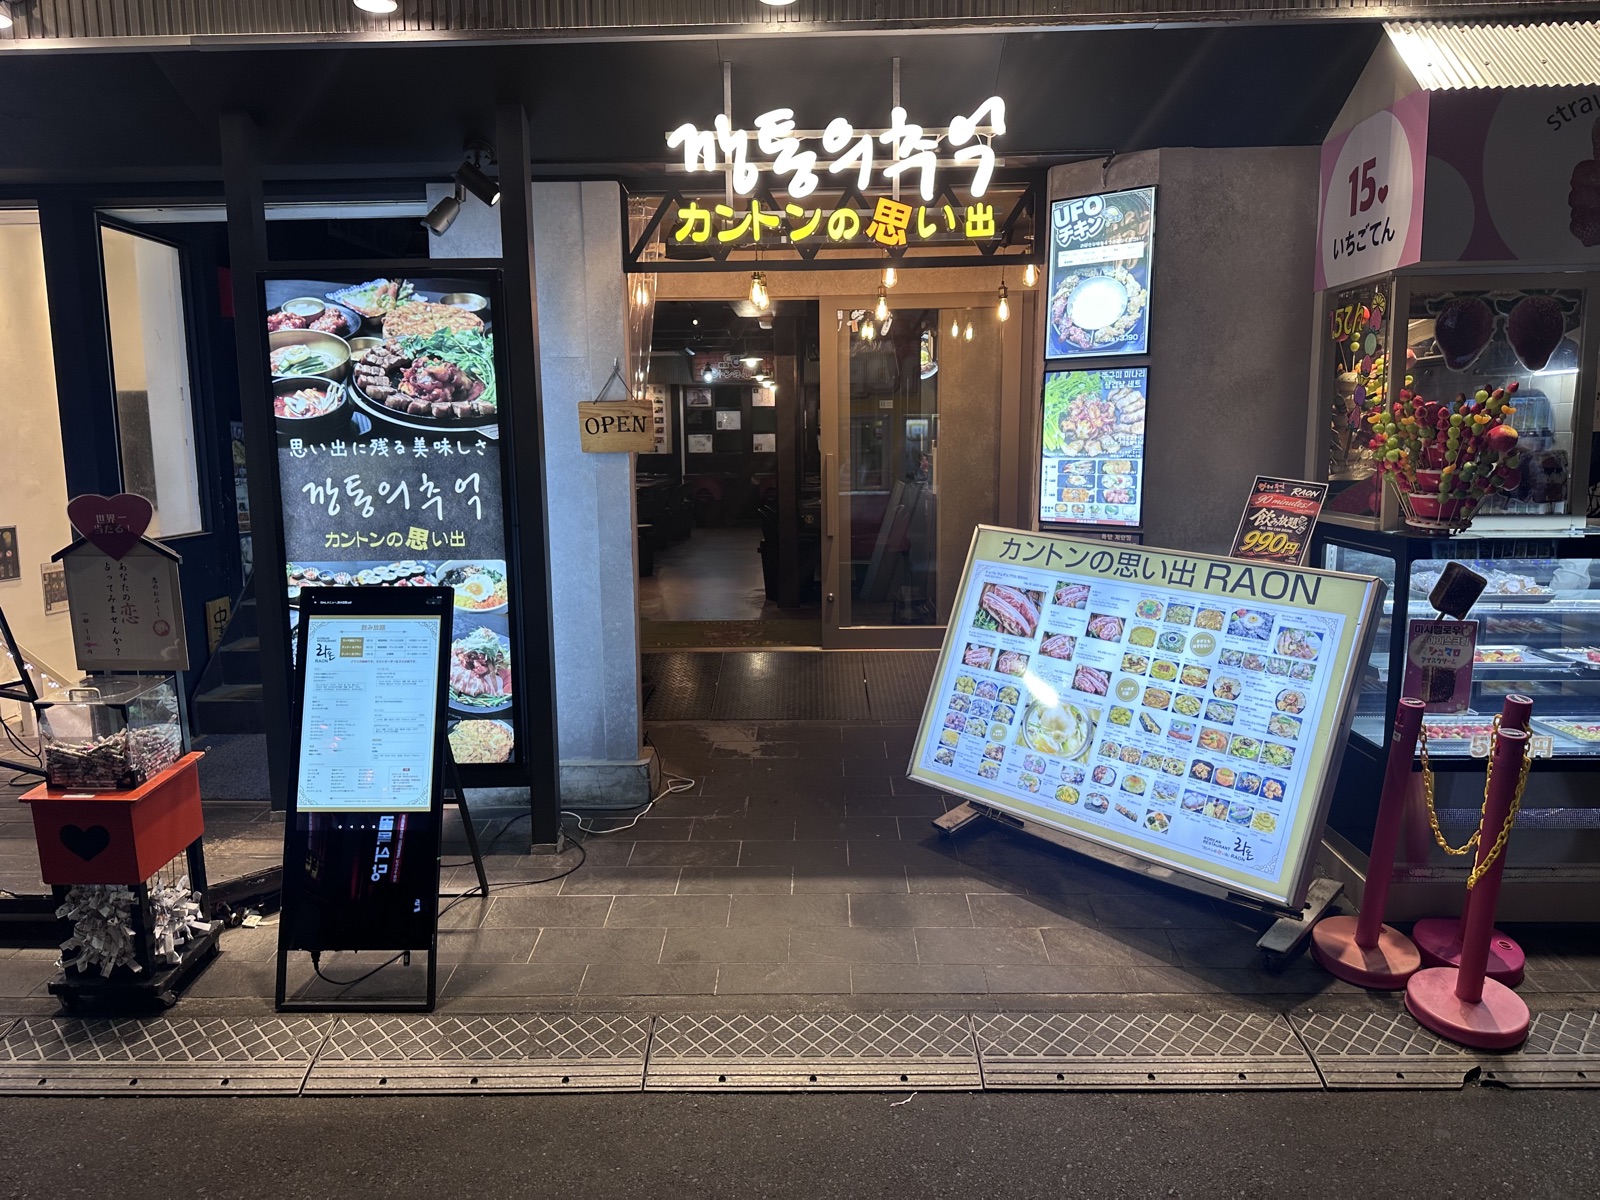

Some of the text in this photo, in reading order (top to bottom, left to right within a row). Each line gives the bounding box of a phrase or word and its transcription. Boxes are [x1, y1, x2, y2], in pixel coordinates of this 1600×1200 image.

[1348, 156, 1377, 217] 15
[675, 197, 996, 248] カントンの思い出
[1054, 195, 1103, 228] UFO
[1058, 217, 1103, 243] チキン
[1333, 217, 1395, 260] いちごてん
[585, 415, 648, 435] OPEN
[289, 436, 487, 458] 思い出に残る美味しさ
[1255, 495, 1314, 509] 90 minutes!
[1290, 487, 1321, 498] RAON
[95, 513, 127, 524] 世界一
[1249, 507, 1299, 530] 飲み放題
[325, 526, 466, 550] カントンの思い出
[1239, 530, 1300, 556] 990円
[998, 537, 1322, 605] カントンの思い出 RAON
[119, 562, 140, 625] あなたの恋
[1414, 624, 1461, 635] 마시멜로우
[1427, 635, 1470, 647] 아이스크림
[1421, 657, 1456, 665] アイスクリーム
[1203, 836, 1222, 845] KOREAN
